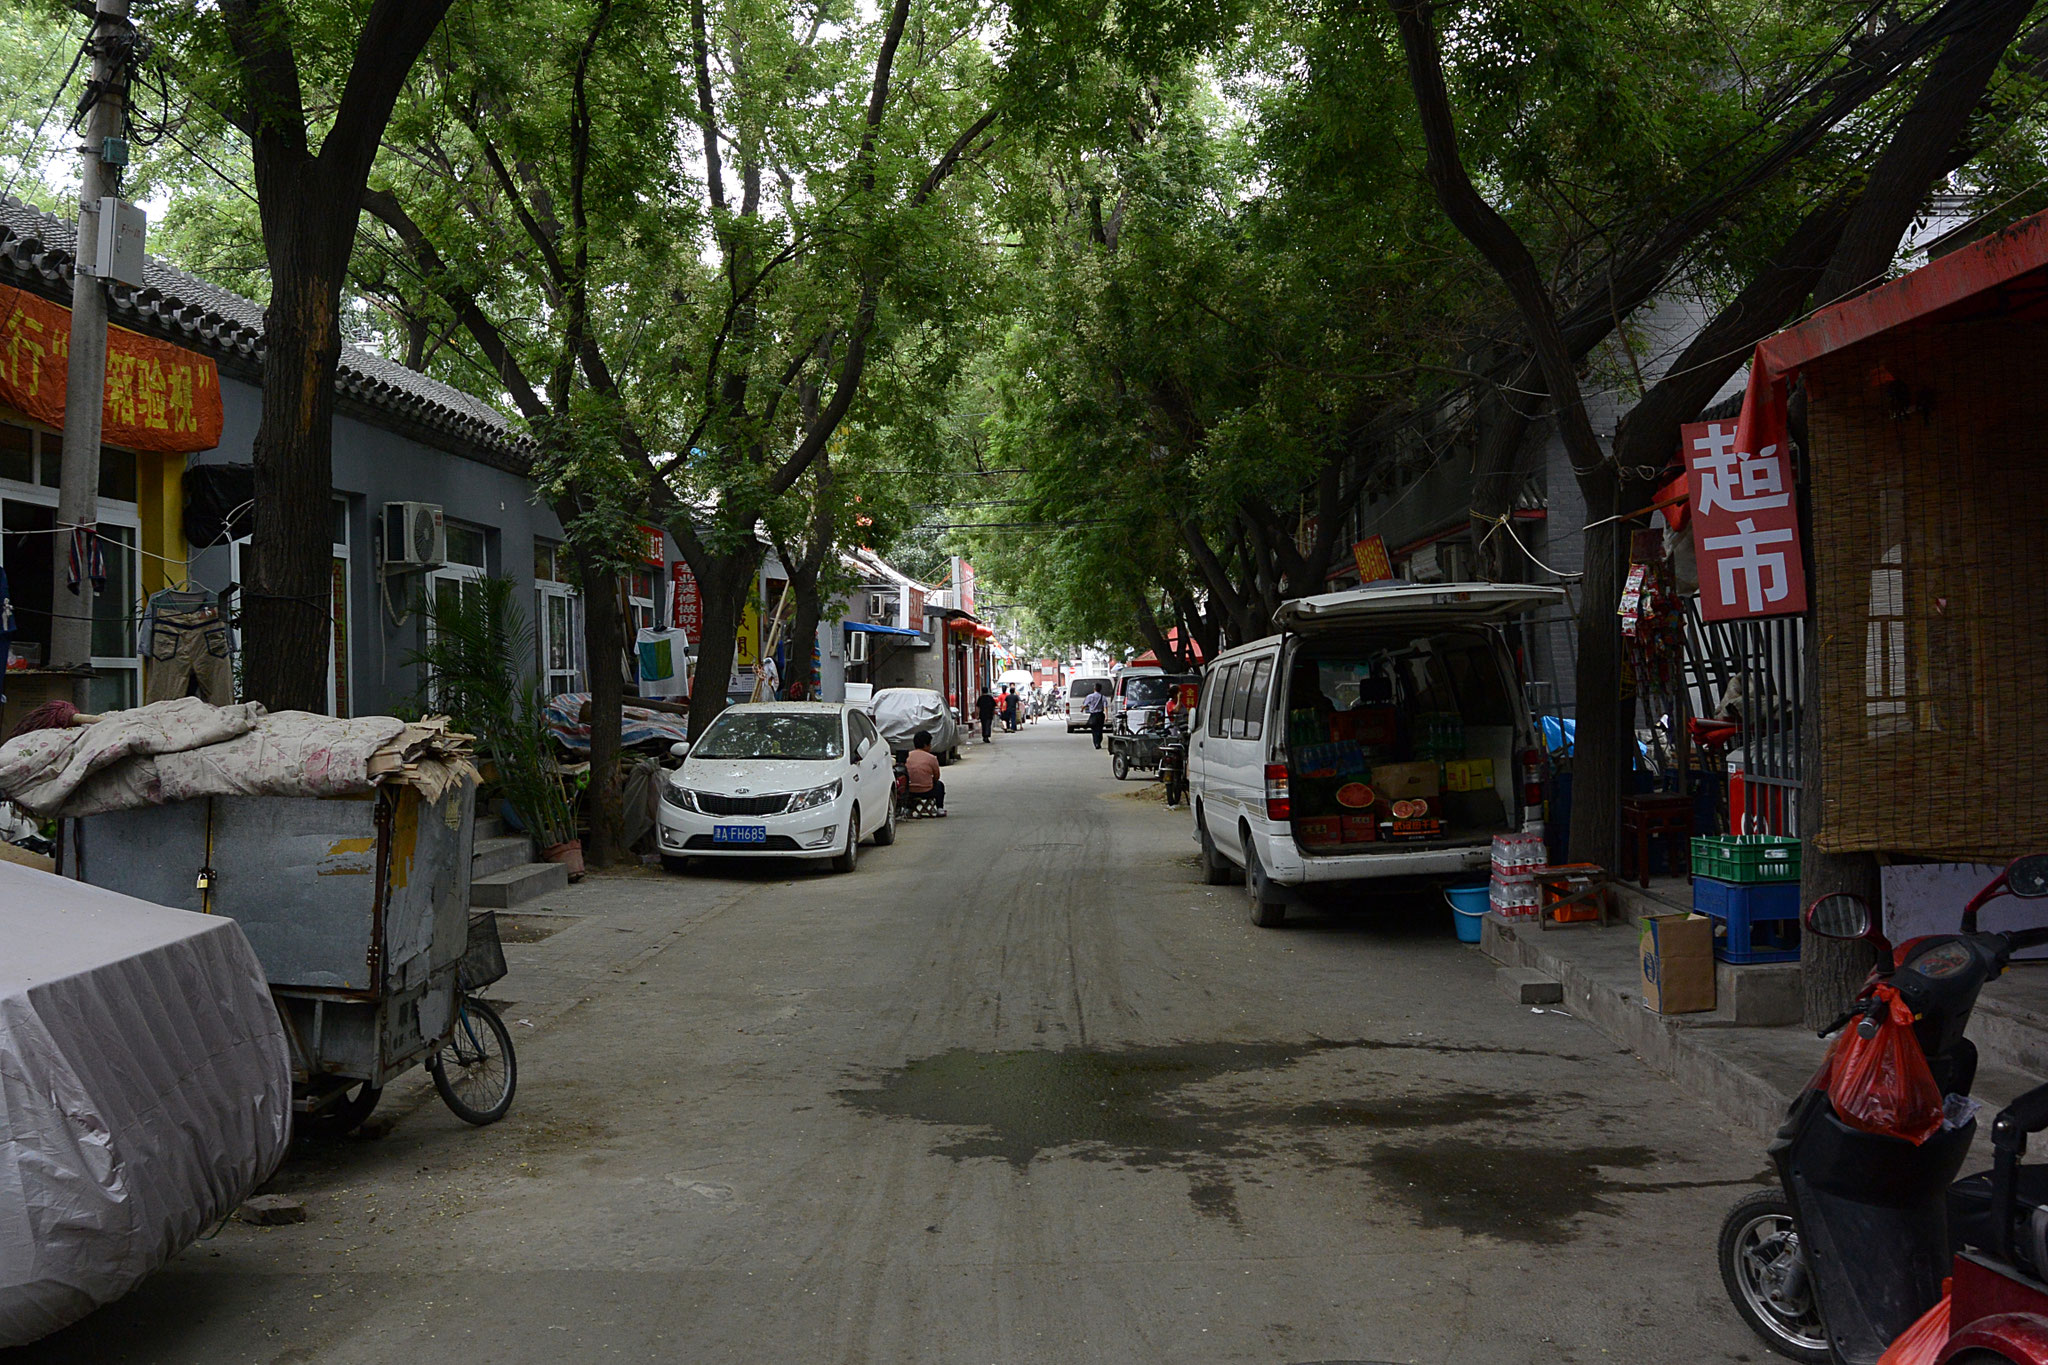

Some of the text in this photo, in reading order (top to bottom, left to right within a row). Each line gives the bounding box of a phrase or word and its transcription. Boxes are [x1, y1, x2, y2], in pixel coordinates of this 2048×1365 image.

[1692, 423, 1794, 613] 超市
[676, 563, 698, 635] 专业装修做防水
